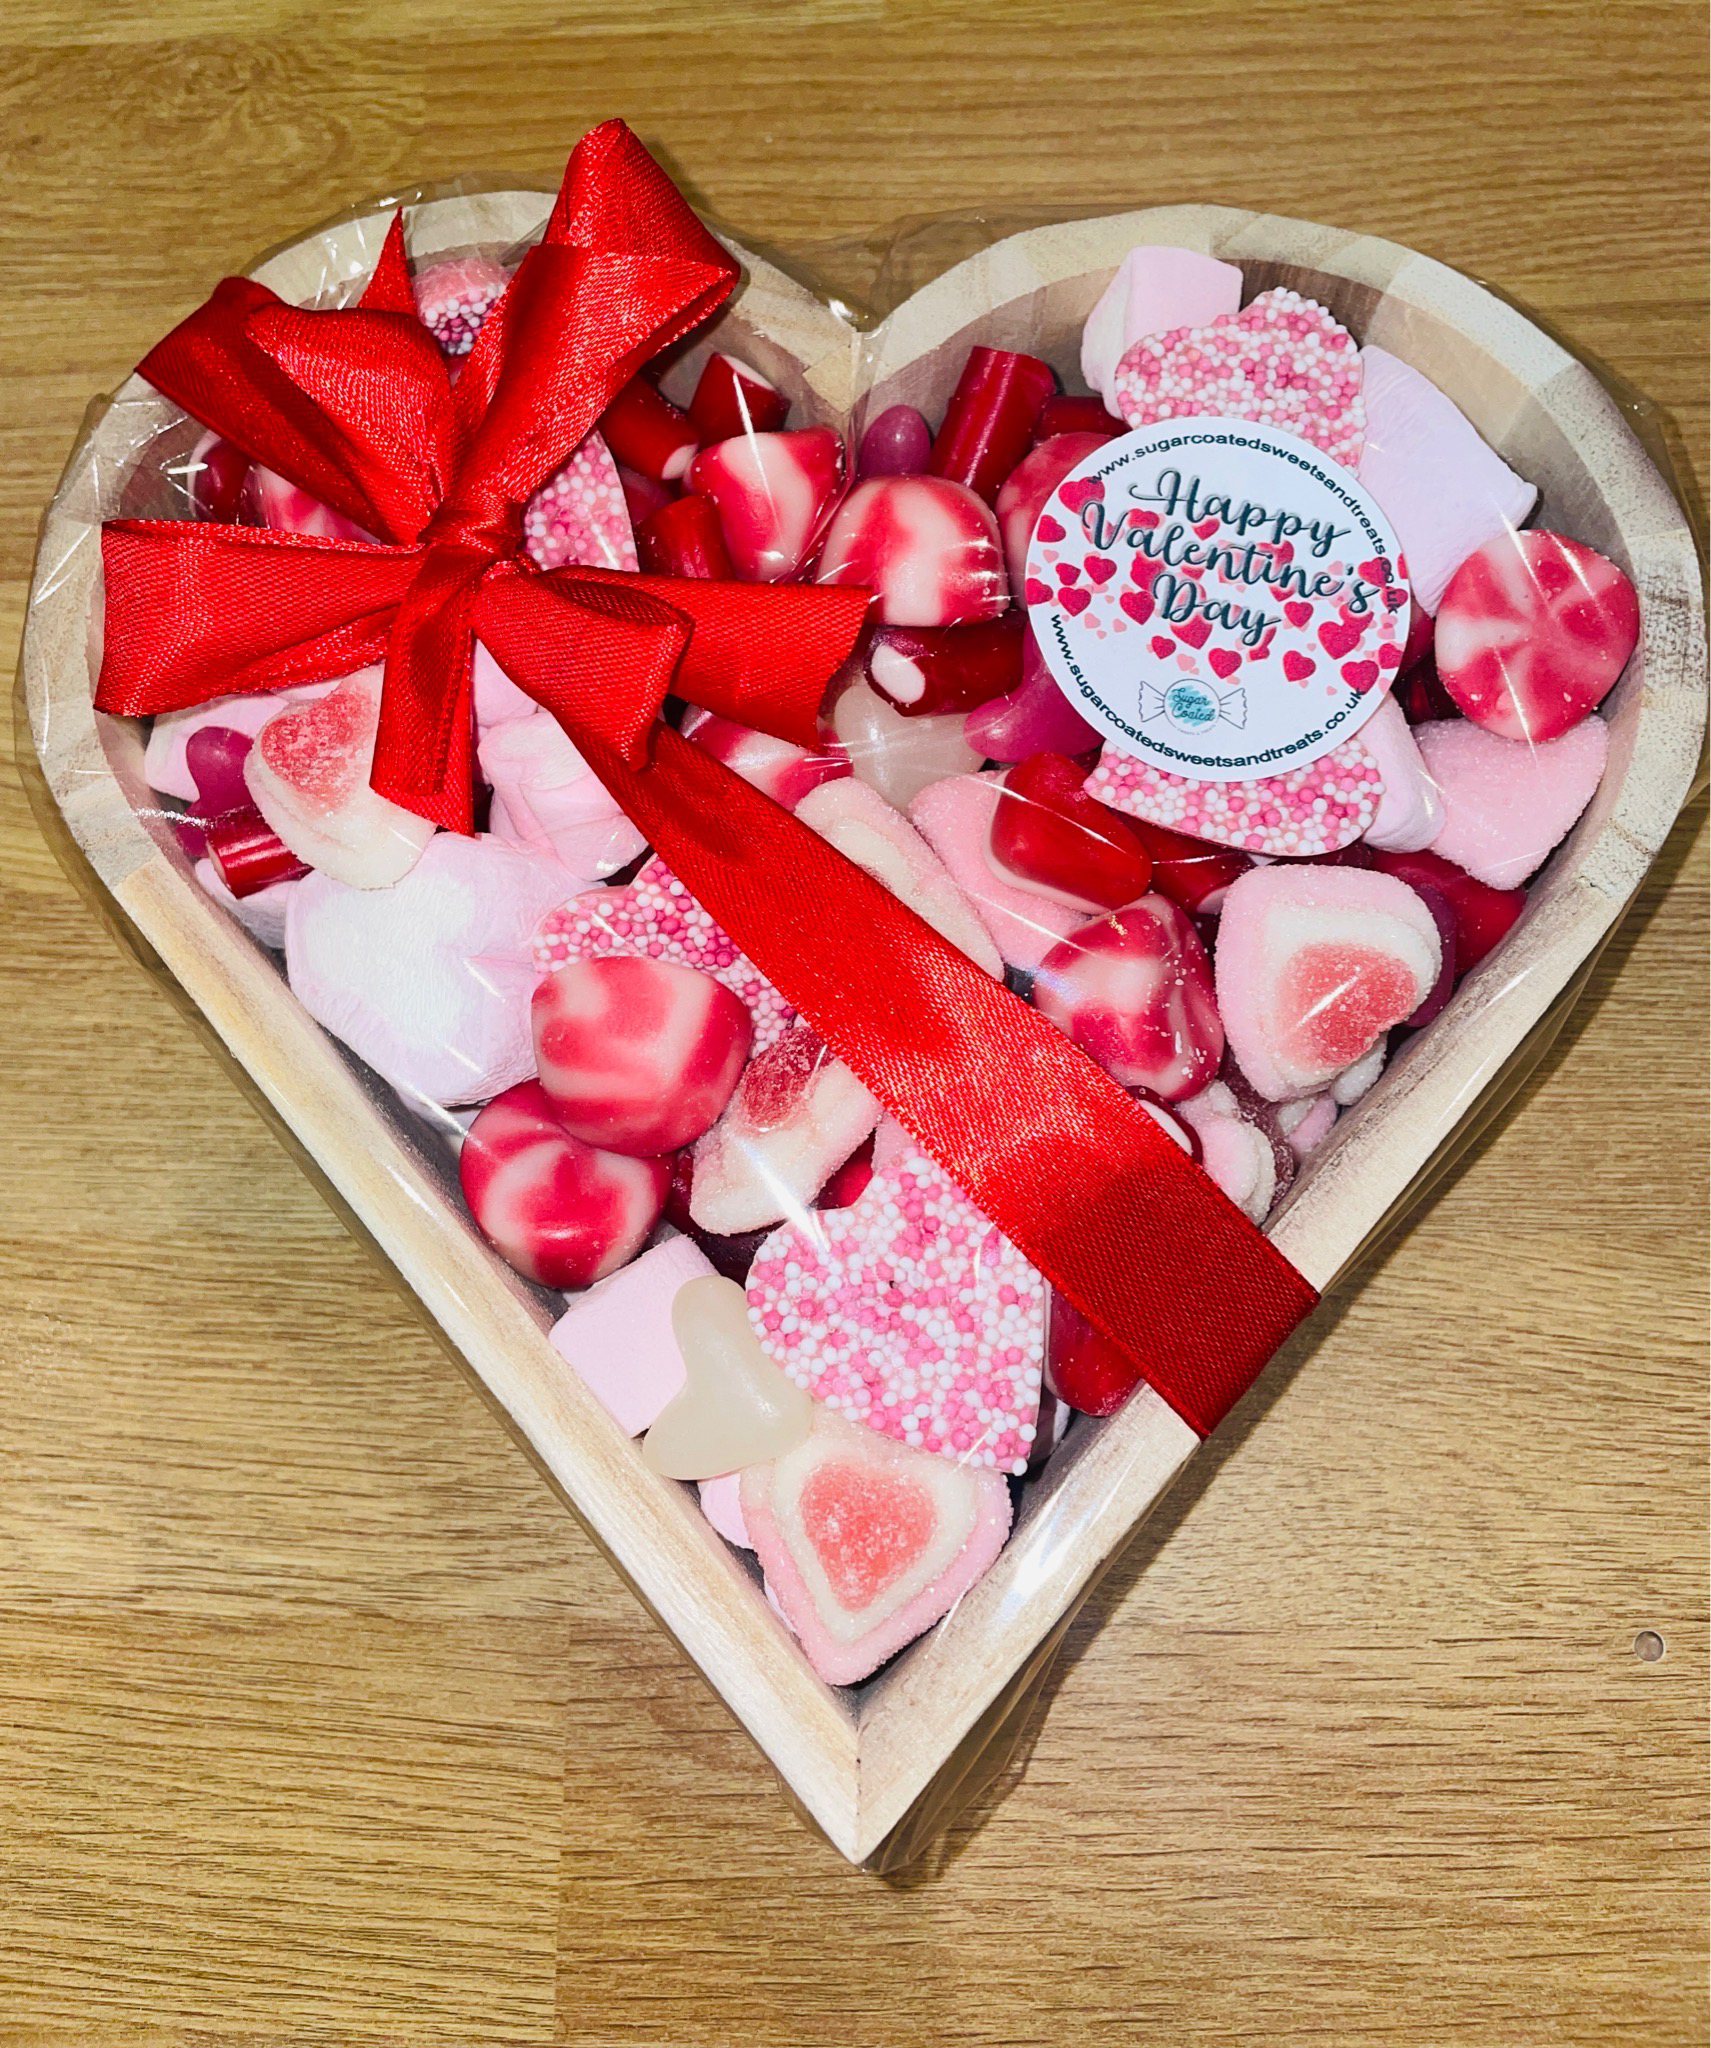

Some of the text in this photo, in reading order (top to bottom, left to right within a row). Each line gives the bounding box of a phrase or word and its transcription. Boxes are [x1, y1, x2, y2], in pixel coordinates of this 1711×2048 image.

[1088, 434, 1398, 615] www.sugarcoatedsweetsandtreats.co.uk
[1129, 468, 1351, 557] Happy
[1081, 501, 1381, 614] Valentine's
[1152, 574, 1281, 647] Day
[1050, 614, 1363, 768] www.sugarcoatedsweetsandtreats.co.uk
[1171, 687, 1210, 708] Sugar
[1171, 702, 1216, 722] Coated
